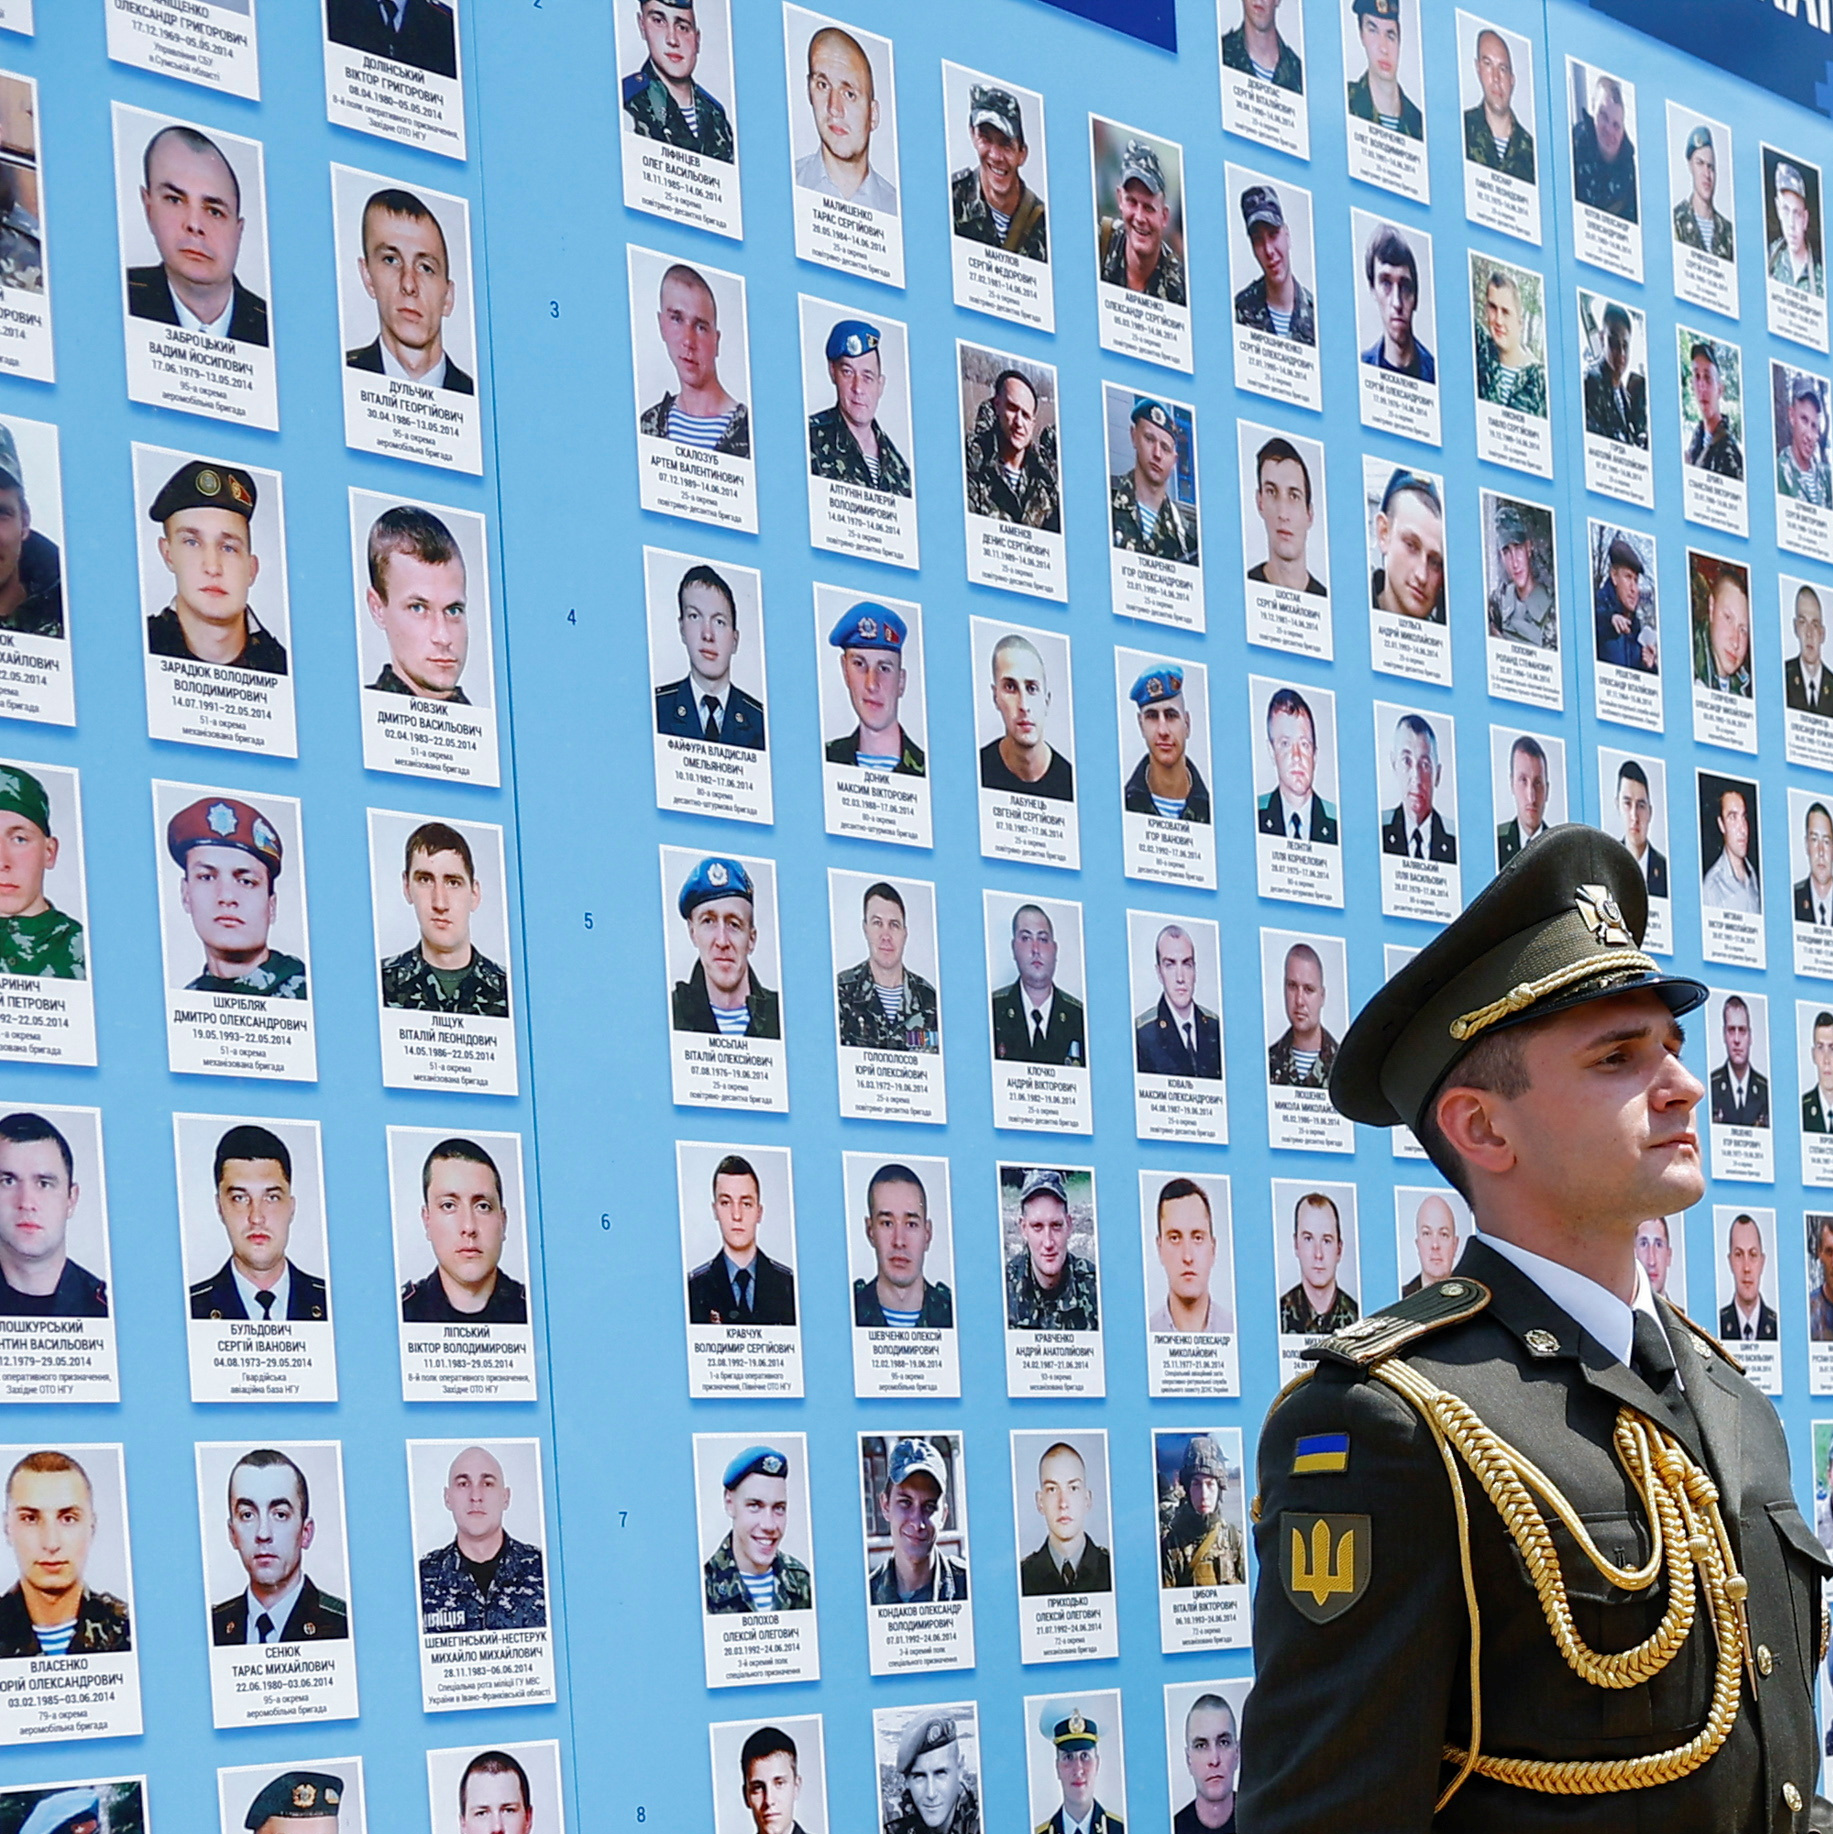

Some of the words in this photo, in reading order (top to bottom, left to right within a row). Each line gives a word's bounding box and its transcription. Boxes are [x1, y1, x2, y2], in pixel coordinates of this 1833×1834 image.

[551, 301, 560, 318] 3
[165, 328, 236, 355] ЗАБРОЦЬКИЙ
[149, 341, 188, 361] ВАДИМ
[188, 347, 254, 376] ЙОСИПОВИЧ
[388, 380, 435, 402] ДУЛЬЧИК
[360, 389, 399, 409] ВІТАЛІЙ
[399, 398, 464, 424] ГЕОРГІЙОВИЧ
[674, 445, 720, 466] СКАЛОЗУБ
[650, 455, 678, 471] АРТЕМ
[679, 461, 745, 486] ВАЛЕНТИНОВИЧ
[568, 609, 577, 626] 4
[160, 659, 212, 679] ЗАРАДЮК
[213, 668, 279, 689] ВОЛОДИМИР
[173, 678, 268, 704] ВОЛОДИМИРОВИЧ
[409, 699, 449, 717] ЙОВЗИК
[377, 710, 418, 727] ДМИТРО
[419, 717, 483, 737] ВАСИЛЬОВИЧ
[667, 739, 707, 755] ФАЙФУРА
[707, 745, 757, 764] ВЛАДИСЛАВ
[682, 756, 744, 776] ОМЕЛЬЯНОВИЧ
[585, 913, 594, 930] 5
[213, 996, 267, 1012] ШКРІБЛЯК
[173, 1009, 217, 1025] ДМИТРО
[219, 1013, 308, 1032] ОЛЕКСАНДРОВИЧ
[431, 1015, 465, 1030] ЛІЩУК
[399, 1028, 436, 1042] ВІТАЛІЙ
[437, 1031, 498, 1048] ЛЕОНІДОВИЧ
[708, 1037, 749, 1051] МОСЬПАН
[684, 1049, 717, 1062] ВІТАЛІЙ
[717, 1052, 773, 1067] ОЛЕКСІЙОВИЧ
[602, 1214, 611, 1231] 6
[230, 1323, 292, 1338] БУЛЬДОВИЧ
[443, 1326, 491, 1339] ЛІПСЬКИЙ
[725, 1328, 763, 1339] КРАВЧУК
[217, 1340, 254, 1352] СЕРГІЙ
[255, 1340, 307, 1353] ІВАНОВИЧ
[407, 1342, 442, 1354] ВІКТОР
[442, 1342, 527, 1356] ВОЛОДИМИРОВИЧ
[694, 1342, 746, 1355] ВОЛОДИМИР
[746, 1343, 795, 1354] СЕРГІЙОВИЧ
[619, 1512, 628, 1528] 7
[741, 1614, 780, 1627] ВОЛОХОВ
[424, 1631, 547, 1649] ШЕМЕГІНСЬКИЙ-НЕСТЕРУК
[722, 1627, 758, 1643] ОЛЕКСІЙ
[758, 1627, 800, 1641] ОЛЕГОВИЧ
[264, 1645, 302, 1659] СЕНЮК
[430, 1649, 478, 1664] МИХАЙЛО
[479, 1646, 543, 1661] МИХАЙЛОВИЧ
[231, 1664, 264, 1677] ТАРАС
[264, 1659, 335, 1675] МИХАЙЛОВИЧ
[637, 1807, 646, 1823] 8
